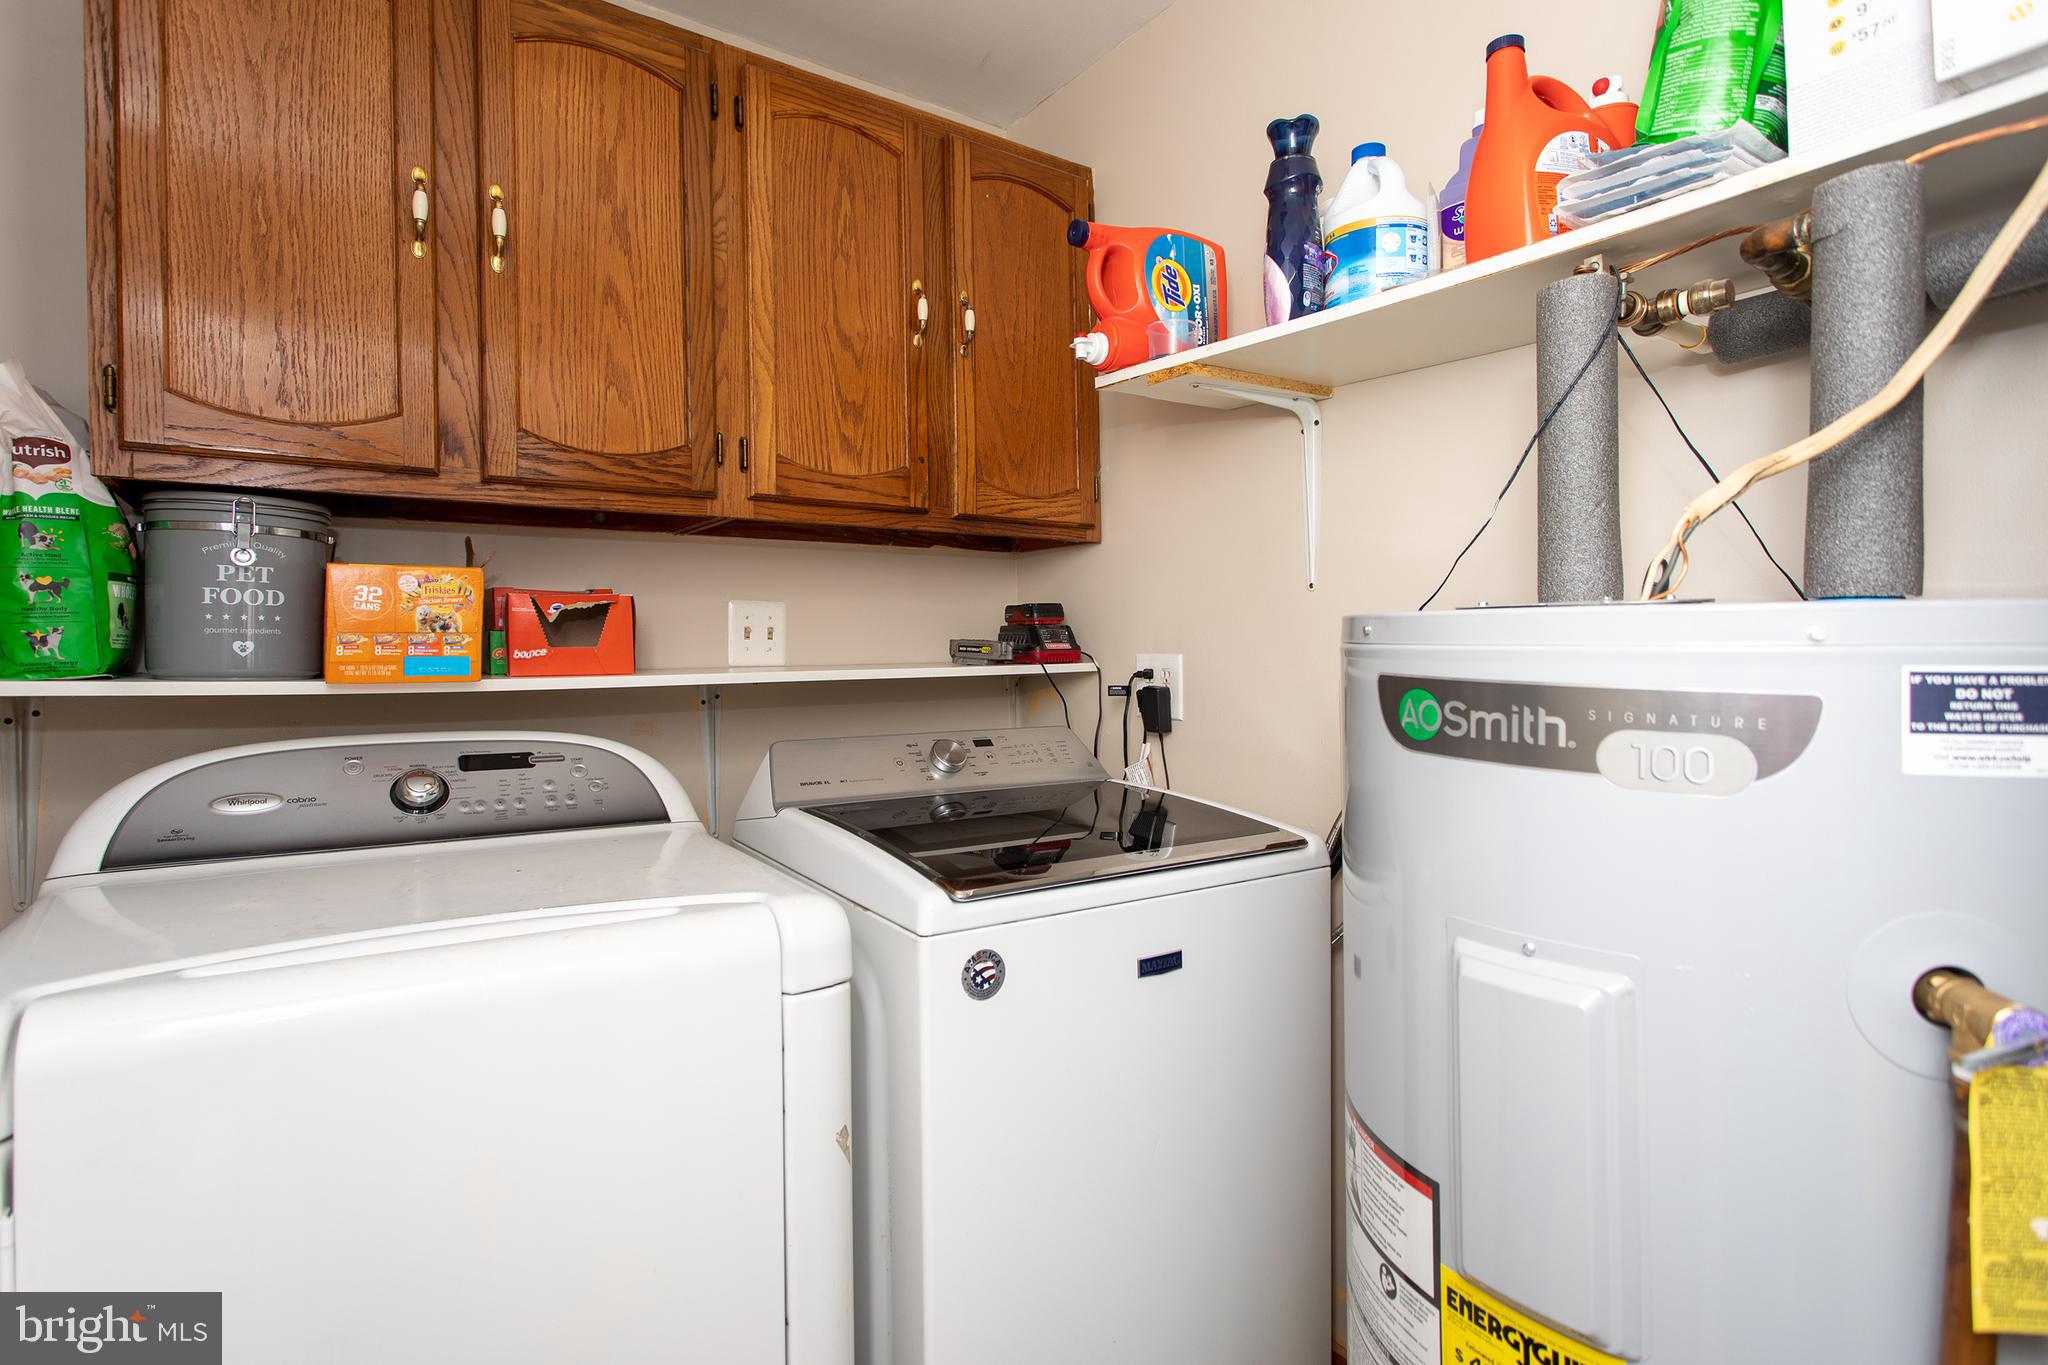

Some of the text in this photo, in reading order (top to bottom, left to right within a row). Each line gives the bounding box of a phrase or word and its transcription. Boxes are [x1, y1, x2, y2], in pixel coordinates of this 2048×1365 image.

[1161, 264, 1186, 307] Tide
[12, 444, 67, 459] utrish
[22, 505, 53, 514] HEALTH
[253, 541, 287, 559] Quality
[216, 564, 274, 583] PET
[353, 584, 383, 603] 32
[424, 585, 456, 596] Friskies
[201, 586, 285, 607] FOOD
[353, 602, 381, 612] CANS
[203, 626, 282, 635] gourmet ingredients
[336, 645, 343, 656] 8
[374, 645, 382, 656] 8
[408, 645, 415, 656] 8
[443, 645, 451, 656] 8
[513, 648, 548, 660] bounce
[1910, 674, 1923, 685] IF
[1925, 674, 1952, 685] YOU
[1953, 675, 1987, 686] HAVE
[1988, 675, 1999, 686] A
[1955, 687, 2014, 700] DO NOT
[1949, 701, 2020, 712] RETURN THIS
[1588, 709, 1768, 731] SIGNATURE
[1944, 712, 2025, 722] WATER HEATER
[1911, 722, 1926, 732] TO
[1926, 722, 1949, 732] THE
[1949, 722, 1983, 732] PLACE
[1984, 722, 1998, 732] OF
[1630, 742, 1715, 785] 100
[226, 798, 268, 807] Whirlpool
[286, 796, 317, 804] cabrio
[964, 950, 1001, 974] AMERICA
[1141, 956, 1181, 974] MAYTAG
